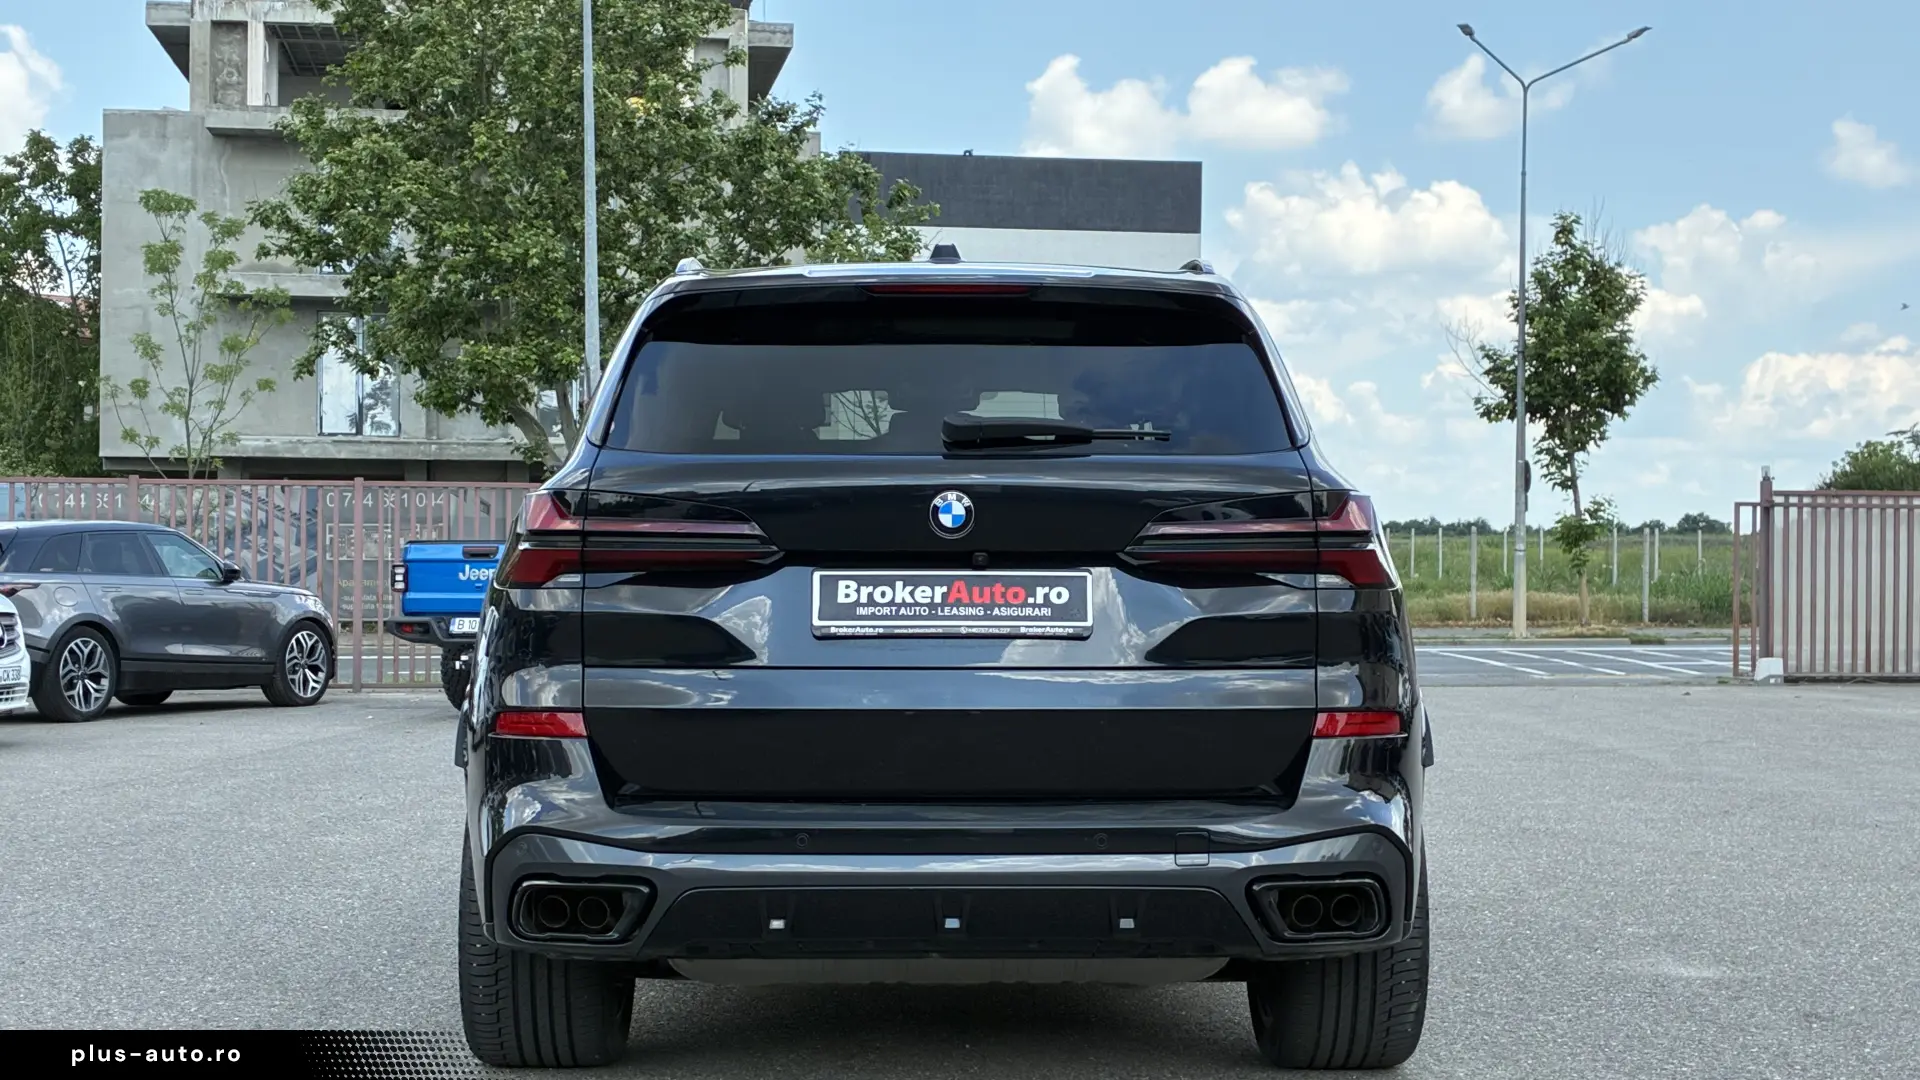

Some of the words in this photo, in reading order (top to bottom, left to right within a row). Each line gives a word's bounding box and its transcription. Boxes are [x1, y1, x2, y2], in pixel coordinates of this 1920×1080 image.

[934, 493, 971, 507] BMW
[837, 580, 1070, 604] BrokerAuto.ro
[856, 606, 897, 616] IMPORT
[899, 606, 929, 616] AUTO
[938, 606, 984, 616] LEASING
[992, 606, 1052, 616] ASIGURARI
[457, 619, 465, 630] B
[830, 626, 884, 634] BrokerAuto.ro
[1019, 626, 1074, 634] BrokerAuto.ro
